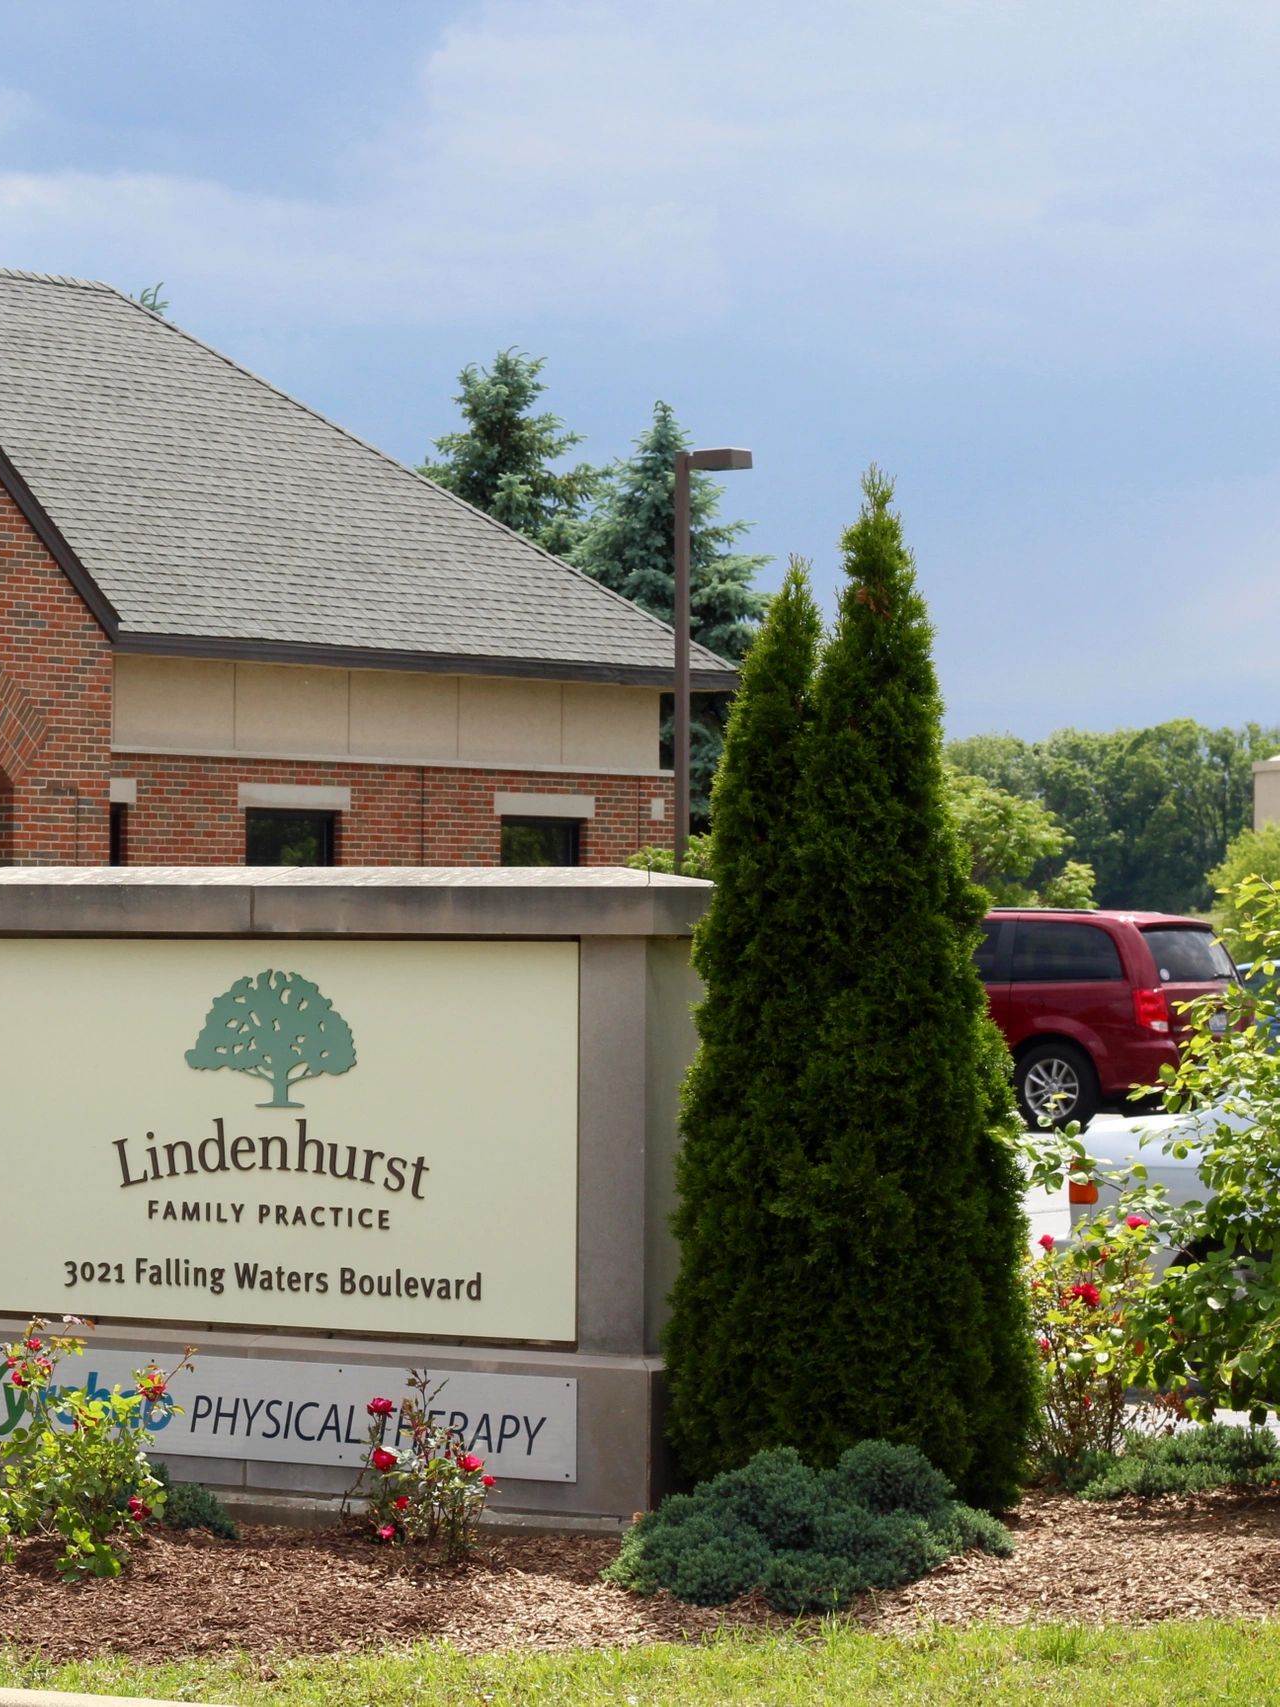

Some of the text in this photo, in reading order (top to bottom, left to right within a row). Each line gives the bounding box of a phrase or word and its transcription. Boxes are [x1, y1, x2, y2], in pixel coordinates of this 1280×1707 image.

[112, 1117, 430, 1200] Lindenhurst
[148, 1200, 391, 1231] FAMILY PRACTICE
[63, 1257, 483, 1301] 3021 Falling Waters Boulevard
[190, 1395, 363, 1444] PHYSICAL
